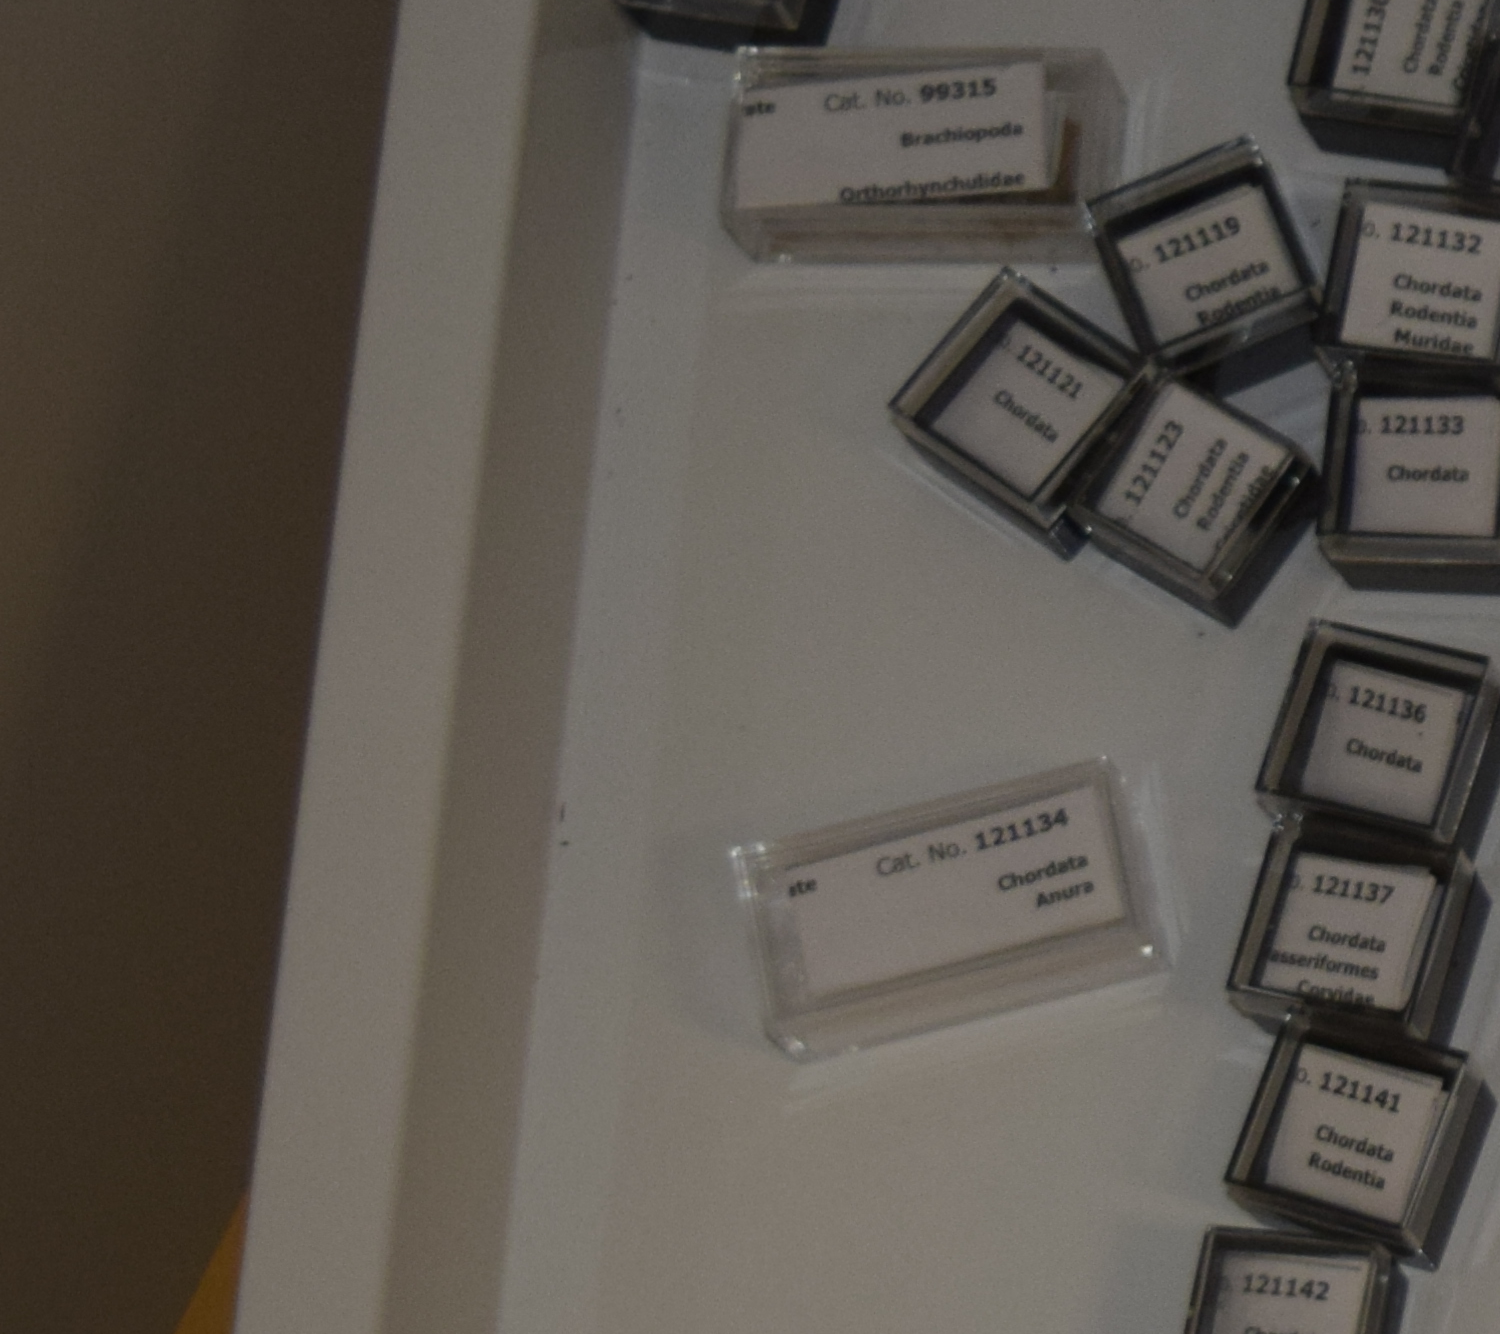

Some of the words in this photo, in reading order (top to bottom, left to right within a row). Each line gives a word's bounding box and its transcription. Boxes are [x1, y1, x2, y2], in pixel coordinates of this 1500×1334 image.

[920, 78, 996, 102] 99315
[1154, 217, 1239, 263] 121119
[1391, 223, 1482, 254] 121132
[1381, 415, 1463, 435] 121133
[975, 808, 1068, 850] 121134
[1319, 1072, 1400, 1113] 121141
[1243, 1275, 1329, 1301] 121142
